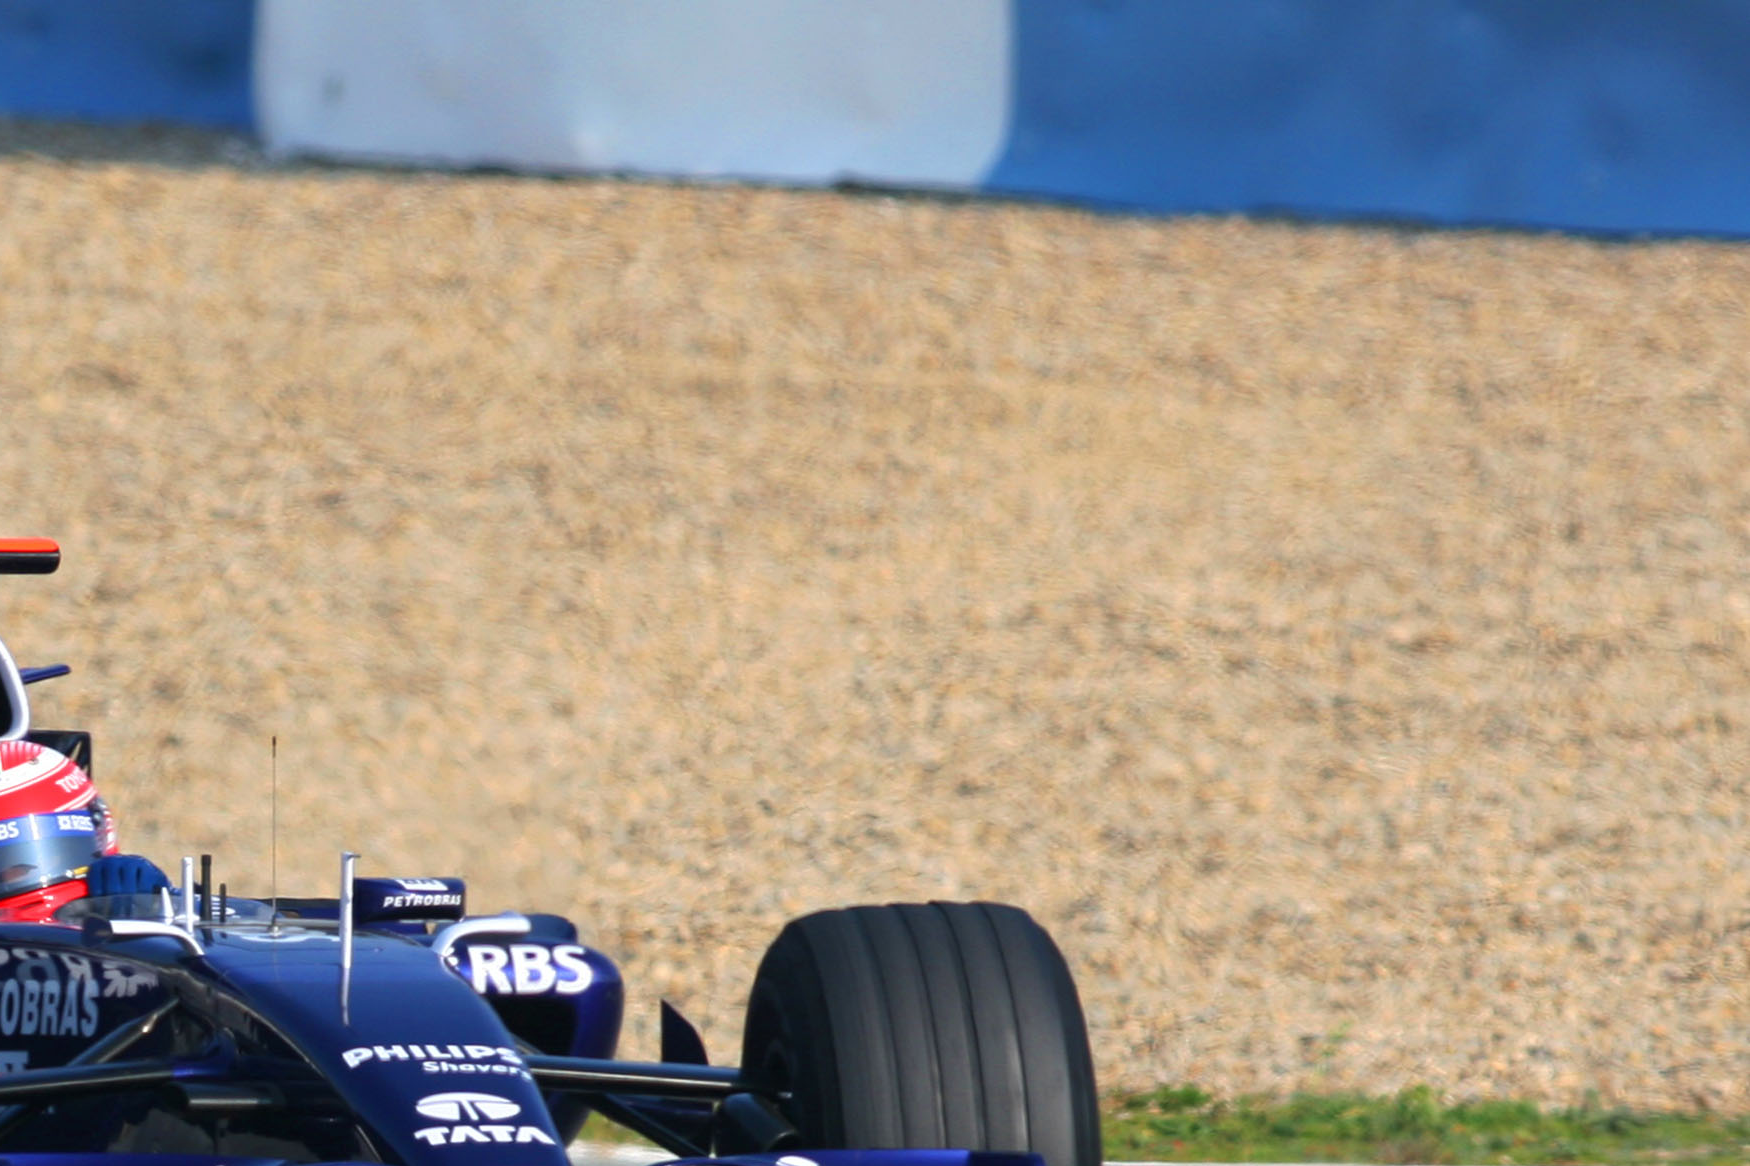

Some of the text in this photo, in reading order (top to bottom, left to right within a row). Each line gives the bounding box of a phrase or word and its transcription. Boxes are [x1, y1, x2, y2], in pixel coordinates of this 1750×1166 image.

[383, 893, 462, 908] PETROBRAS
[467, 943, 594, 995] RBS
[342, 1044, 523, 1070] PHILIPS
[422, 1060, 533, 1082] Shavers
[414, 1125, 557, 1146] TATA
